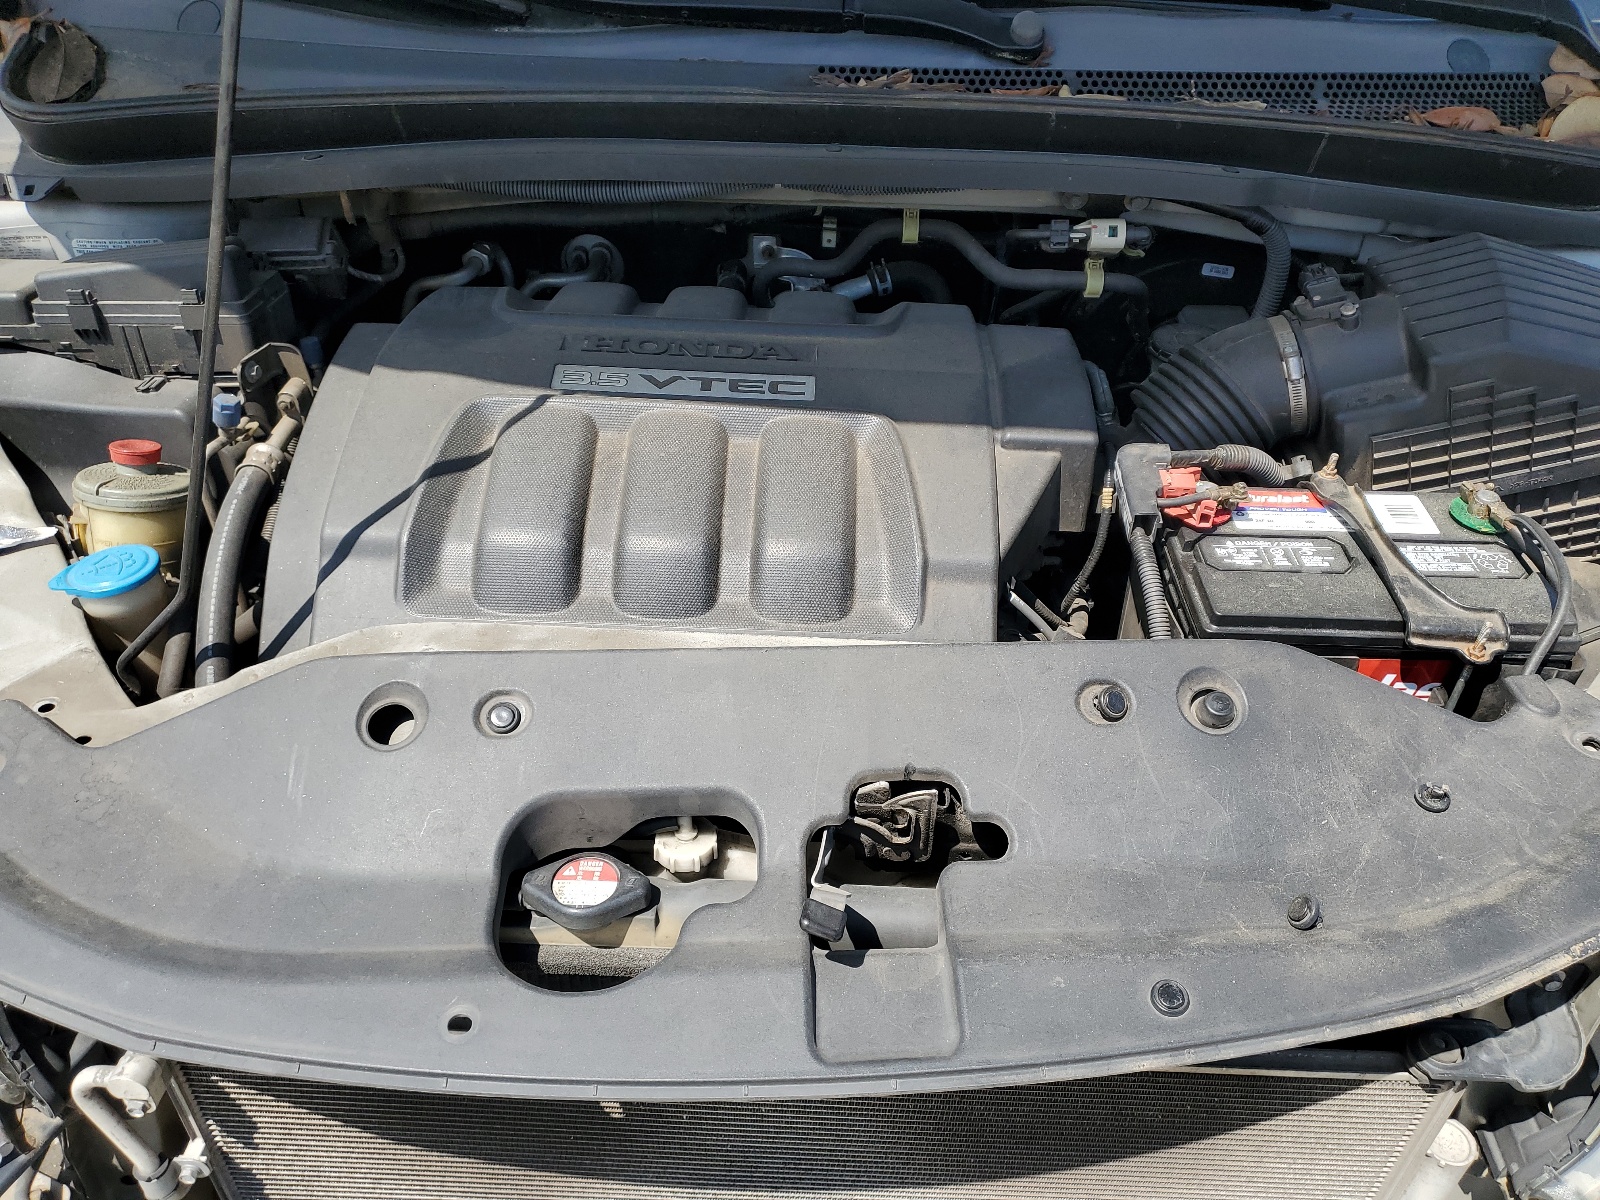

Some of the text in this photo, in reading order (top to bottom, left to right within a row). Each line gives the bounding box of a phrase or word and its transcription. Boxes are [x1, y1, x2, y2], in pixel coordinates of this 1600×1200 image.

[581, 336, 799, 361] HONDA
[560, 369, 806, 396] 3.5 VTEC
[1248, 494, 1309, 503] uralast
